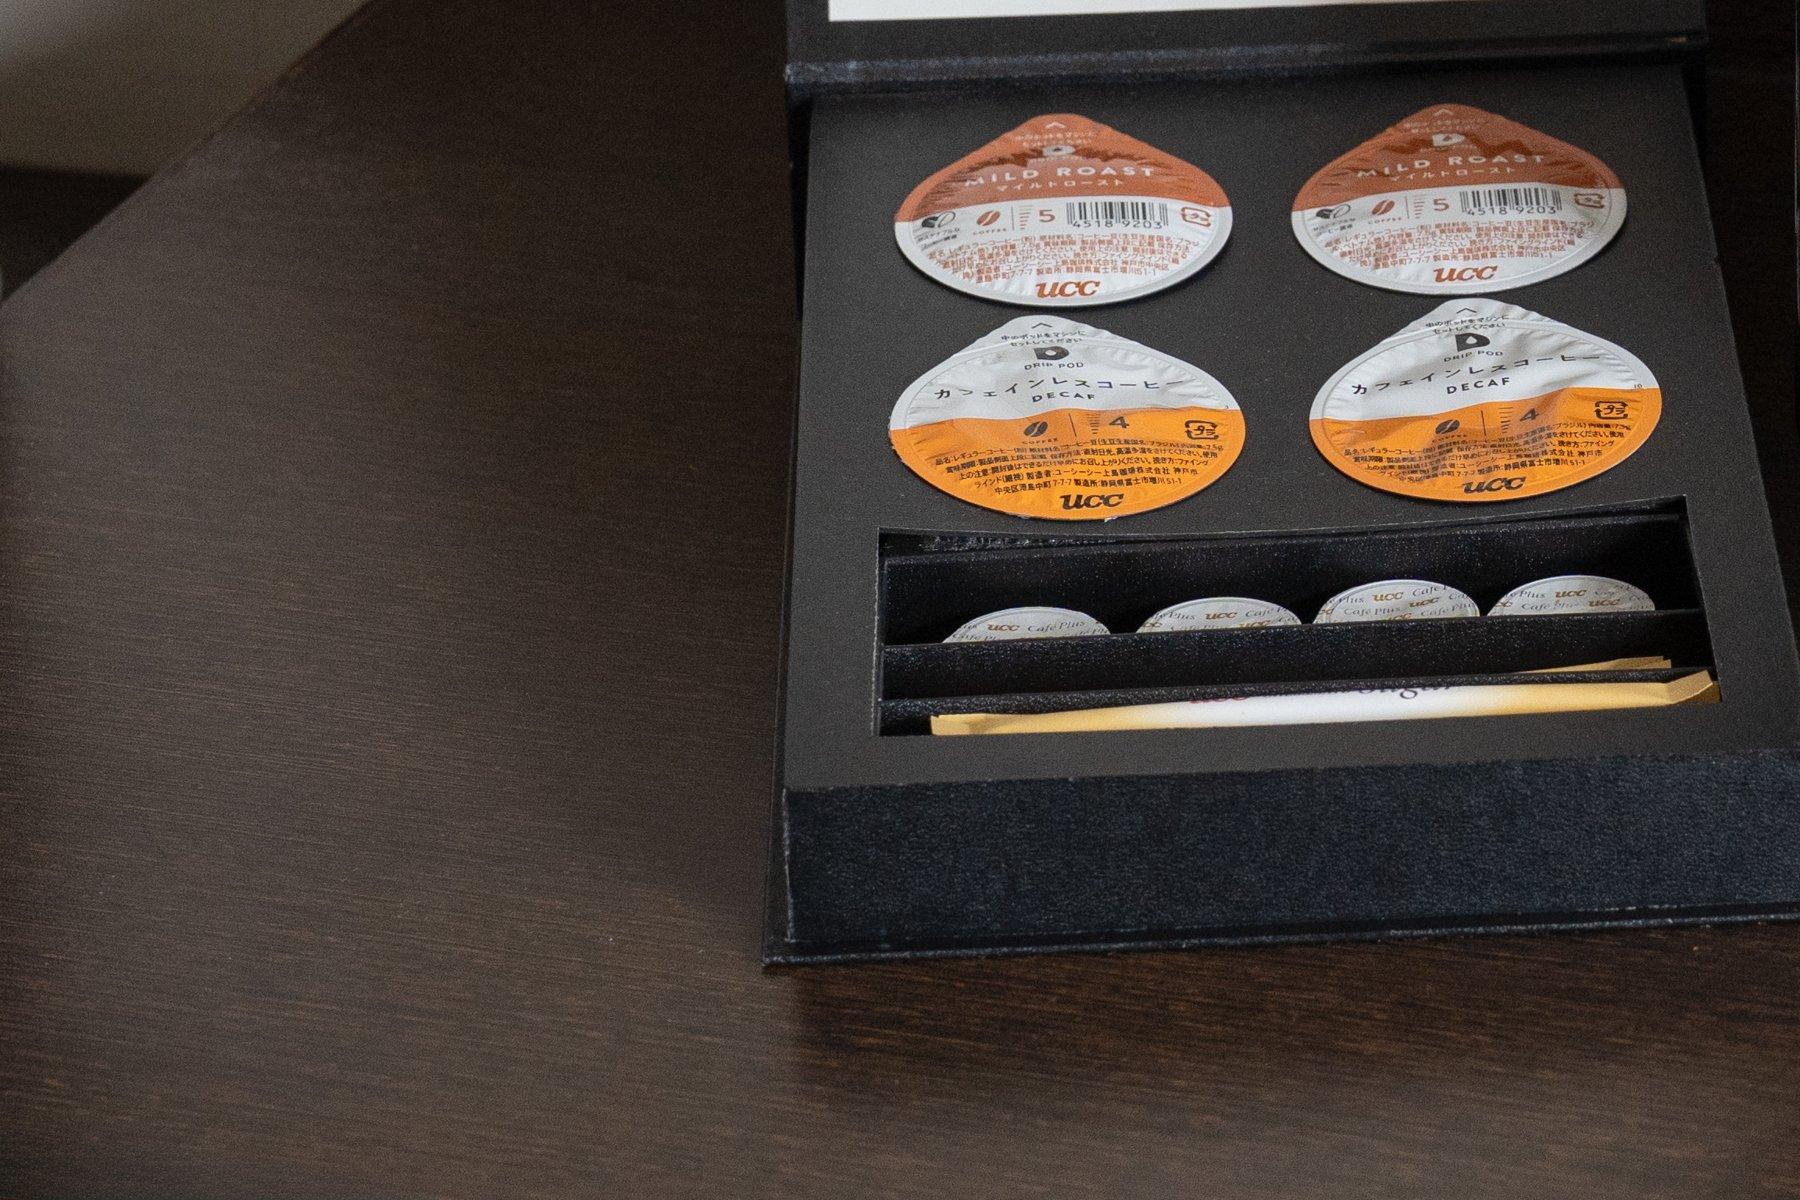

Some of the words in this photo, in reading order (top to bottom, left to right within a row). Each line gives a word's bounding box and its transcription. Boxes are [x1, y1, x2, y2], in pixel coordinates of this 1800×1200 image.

[1357, 160, 1430, 177] MILD
[1448, 155, 1545, 165] ROAST
[965, 169, 1040, 187] MILD
[1056, 166, 1155, 176] ROAST
[997, 179, 1124, 191] マイルドロースト
[1433, 199, 1449, 211] 5
[1468, 204, 1508, 215] 4518
[1517, 202, 1556, 214] 9203
[1038, 209, 1055, 223] 5
[1073, 219, 1113, 230] 4518
[1122, 219, 1162, 230] 9203
[1444, 351, 1473, 362] DRIP
[1024, 362, 1053, 370] DRIP
[1352, 353, 1601, 395] カフェインレスコーヒー
[936, 376, 1184, 400] カフェインレスコーヒー
[1446, 377, 1511, 395] DECAF
[1032, 391, 1095, 403] DECAF
[1520, 408, 1539, 422] 4
[1110, 416, 1129, 429] 4
